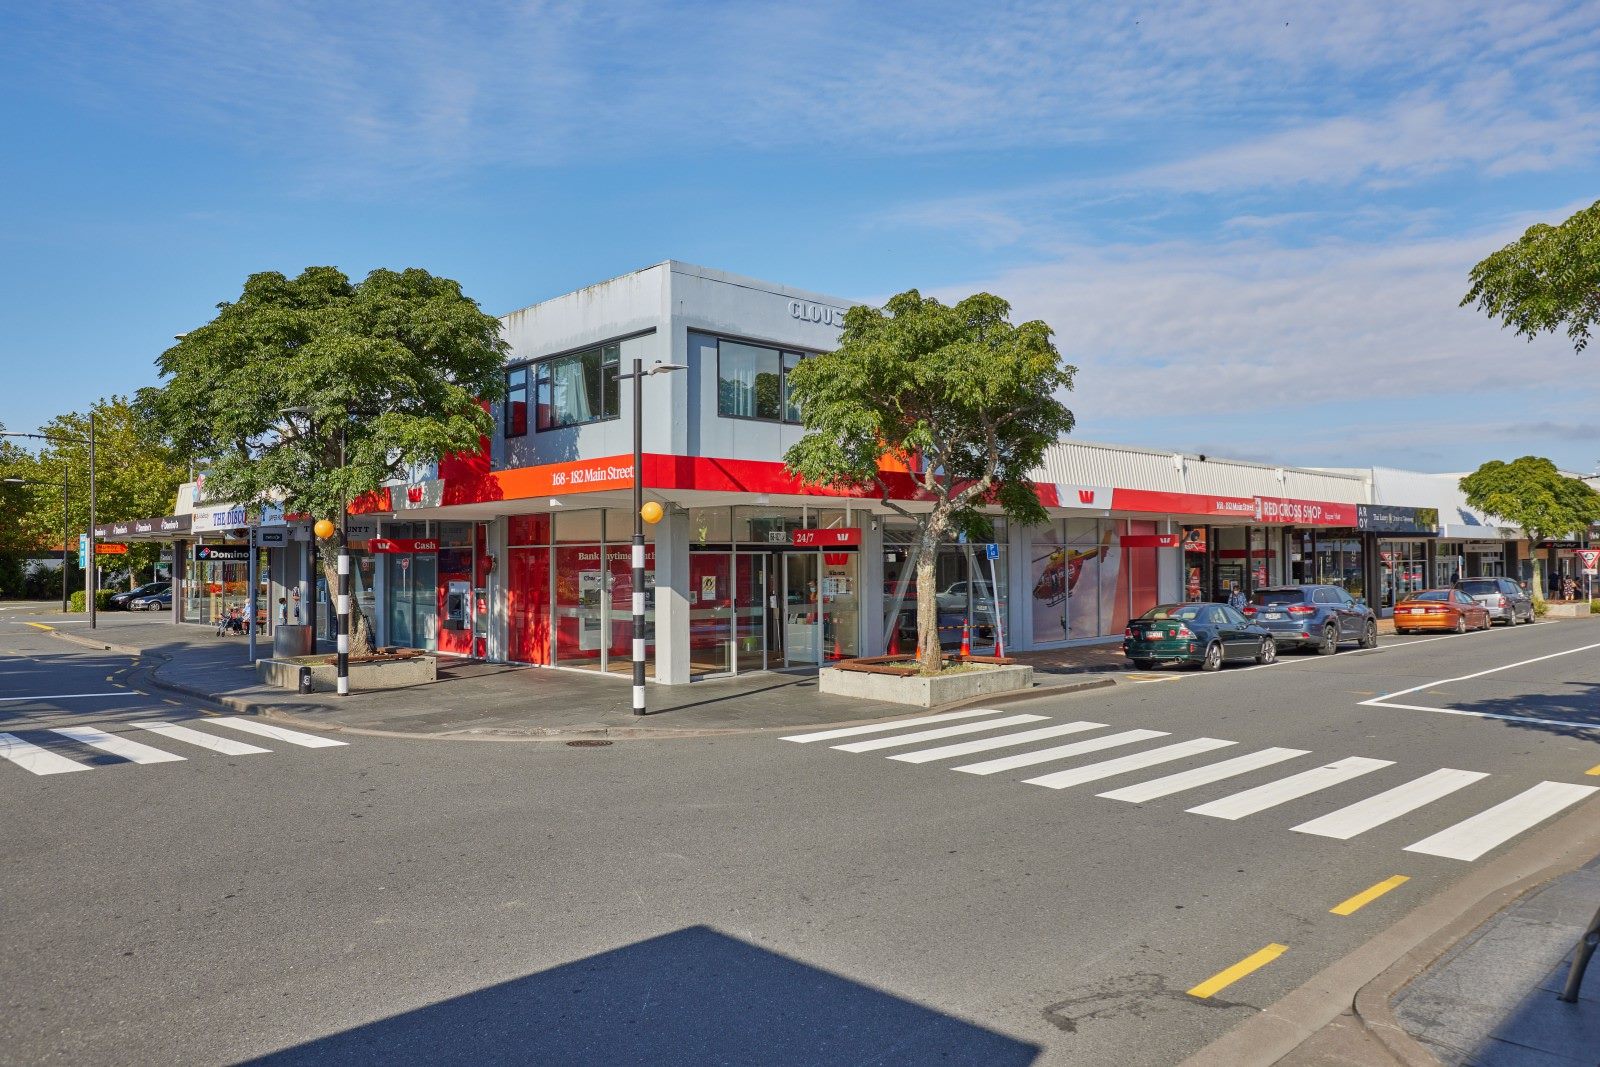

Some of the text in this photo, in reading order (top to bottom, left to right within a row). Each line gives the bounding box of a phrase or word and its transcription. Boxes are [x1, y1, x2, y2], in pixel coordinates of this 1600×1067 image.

[788, 300, 844, 328] CLOUS
[552, 472, 566, 486] 168
[570, 470, 583, 484] 182
[584, 467, 606, 483] Main
[607, 466, 635, 481] Street
[1263, 501, 1278, 516] RED
[1279, 504, 1302, 518] CROSS
[1303, 505, 1322, 519] SHOP
[1359, 506, 1368, 516] AR
[213, 512, 226, 526] THE
[1359, 518, 1369, 529] OY
[796, 532, 815, 543] 24/7
[414, 542, 436, 550] Cash
[210, 550, 249, 559] Domino
[578, 552, 632, 561] Bank nytime
